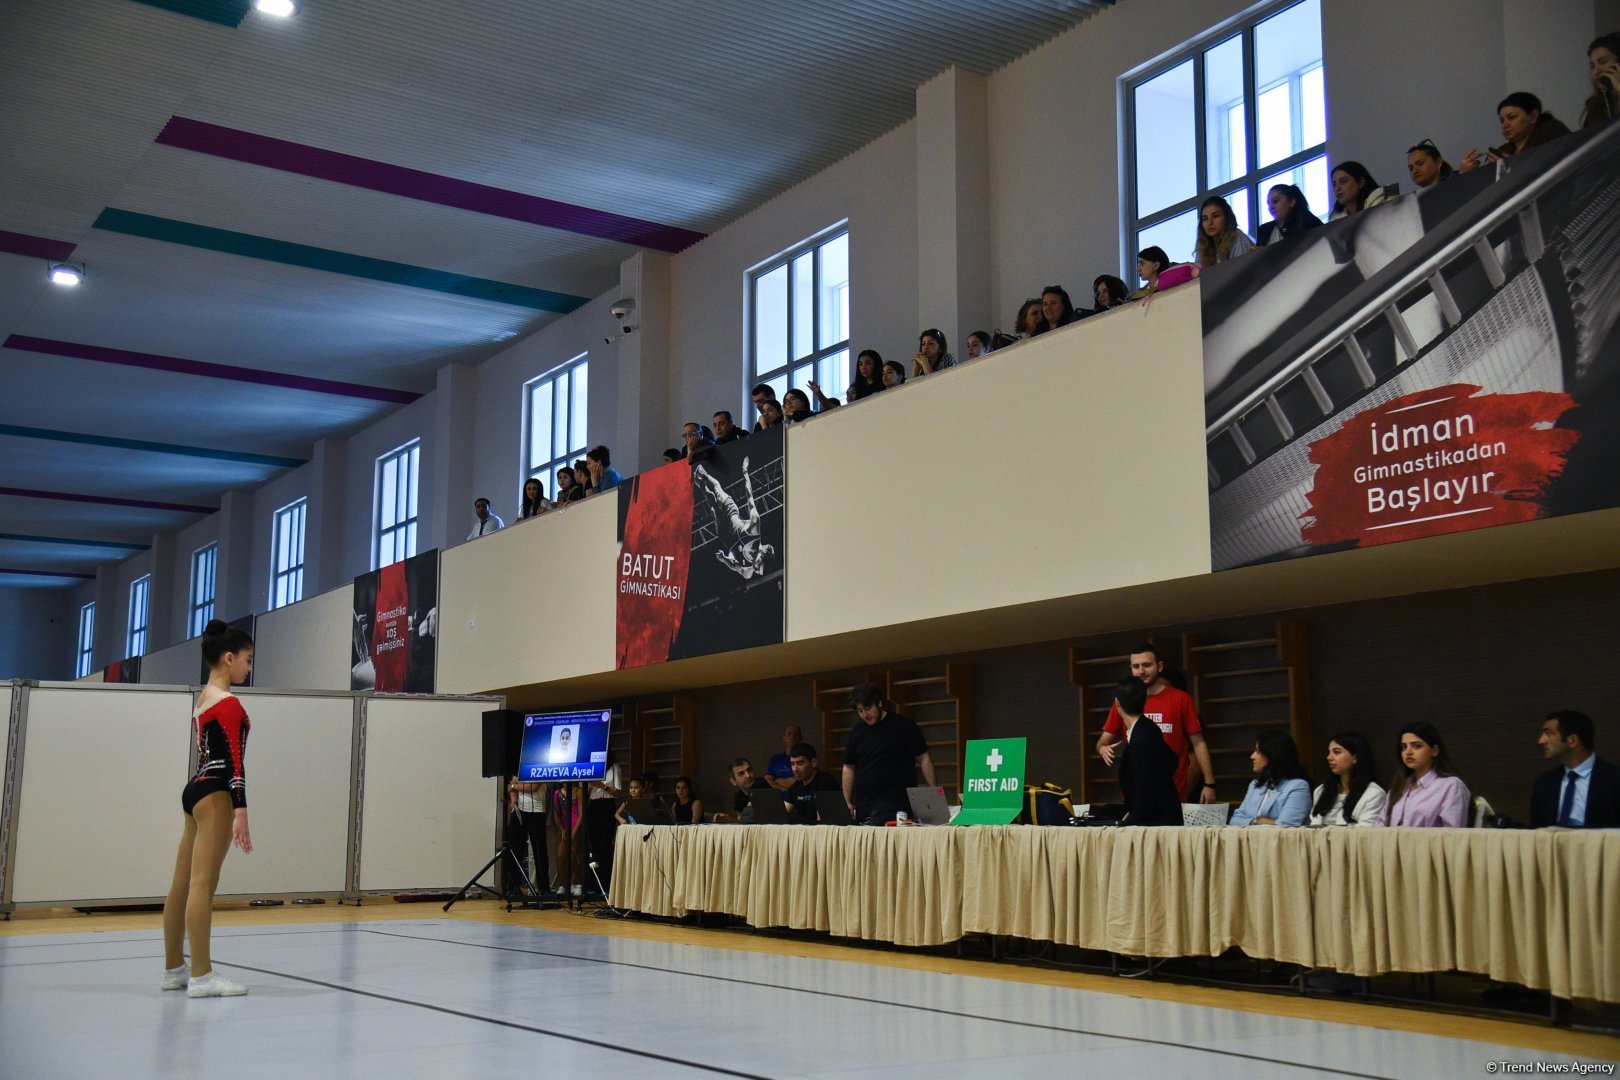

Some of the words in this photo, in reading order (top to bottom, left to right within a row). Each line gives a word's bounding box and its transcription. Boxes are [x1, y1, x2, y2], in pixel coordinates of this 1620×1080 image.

[1370, 414, 1474, 455] İdman
[1353, 440, 1506, 483] Gimnastikadan
[1367, 471, 1495, 513] Başlayır
[622, 552, 675, 580] BATUT
[620, 578, 681, 600] GİMNASTİKASI
[530, 766, 570, 778] RZAYEVA
[571, 765, 595, 779] Aysel
[968, 778, 998, 792] FIRST
[1000, 777, 1019, 791] AID
